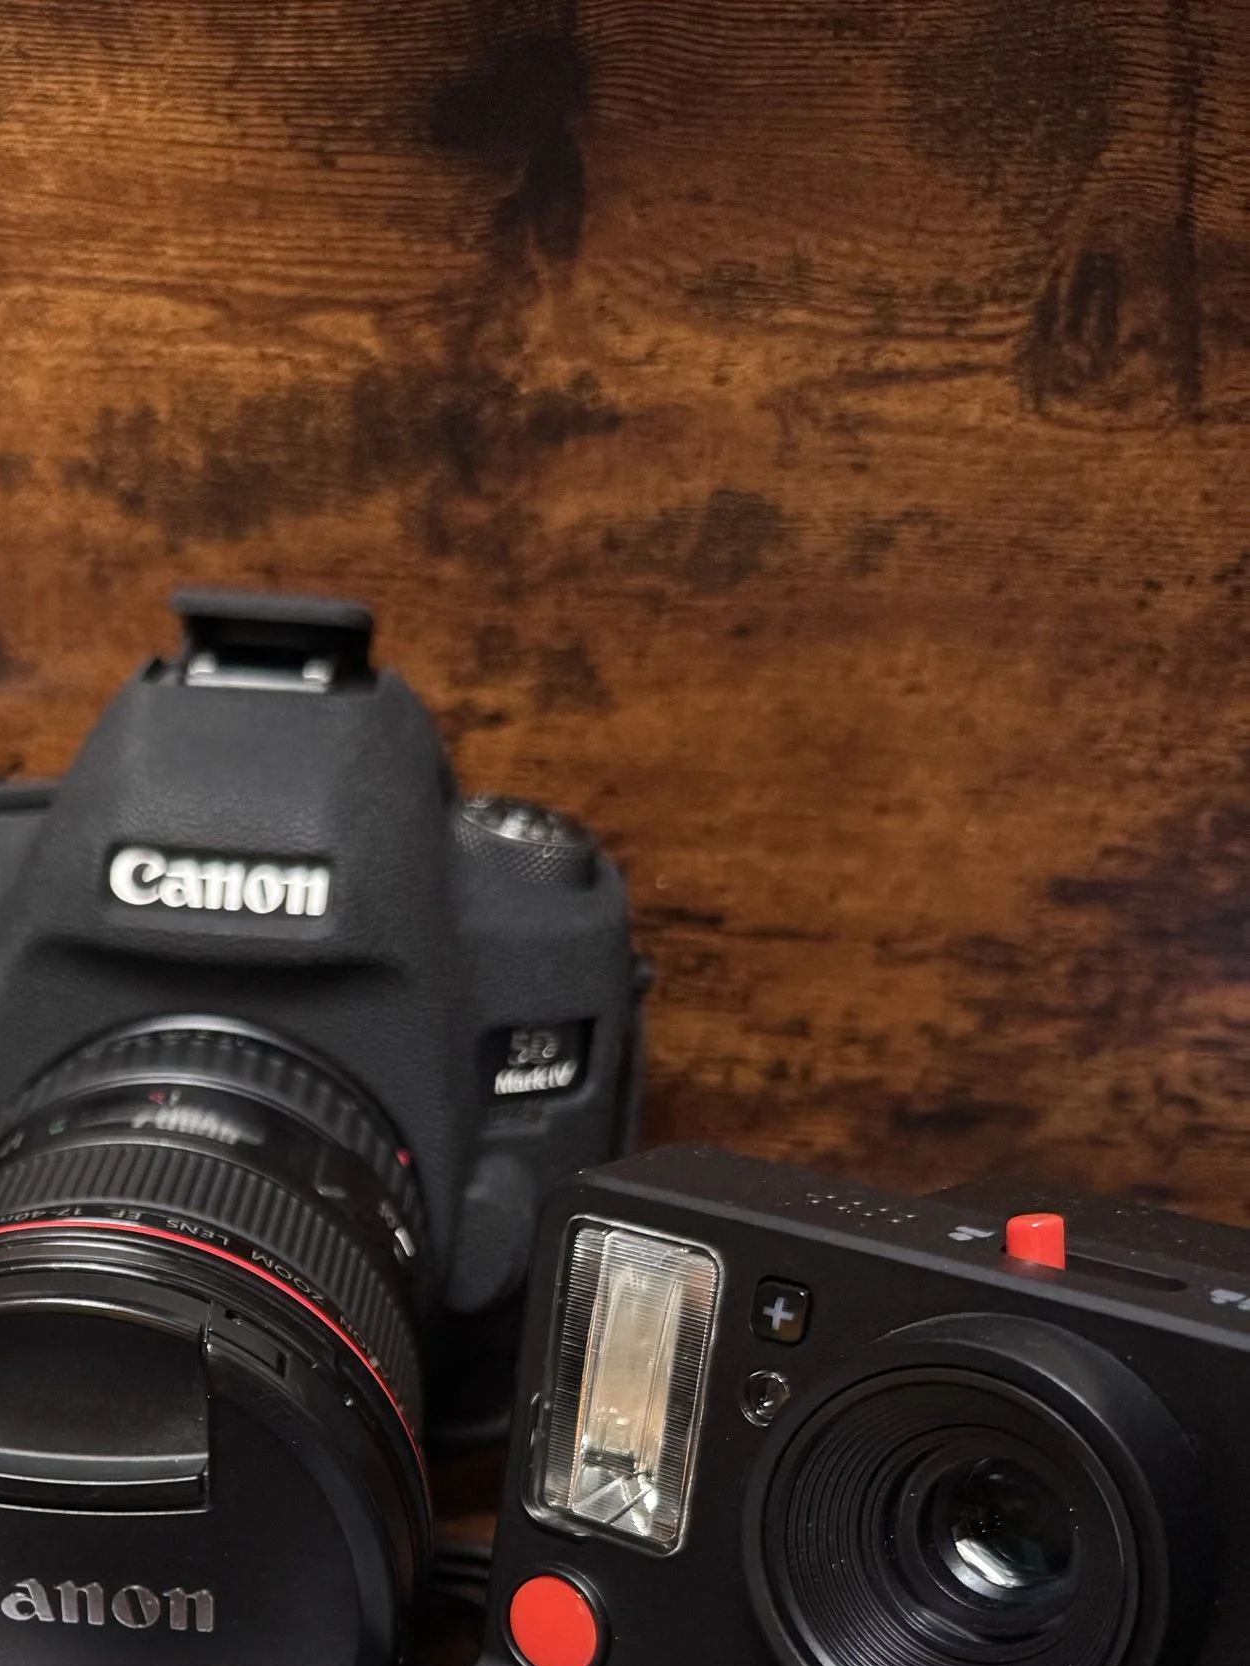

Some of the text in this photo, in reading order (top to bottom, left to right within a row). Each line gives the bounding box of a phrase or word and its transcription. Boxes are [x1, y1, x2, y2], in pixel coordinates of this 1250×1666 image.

[109, 847, 330, 917] Canon
[111, 1209, 143, 1221] EF
[166, 1218, 230, 1247] LENS
[251, 1250, 325, 1304] ZOOM
